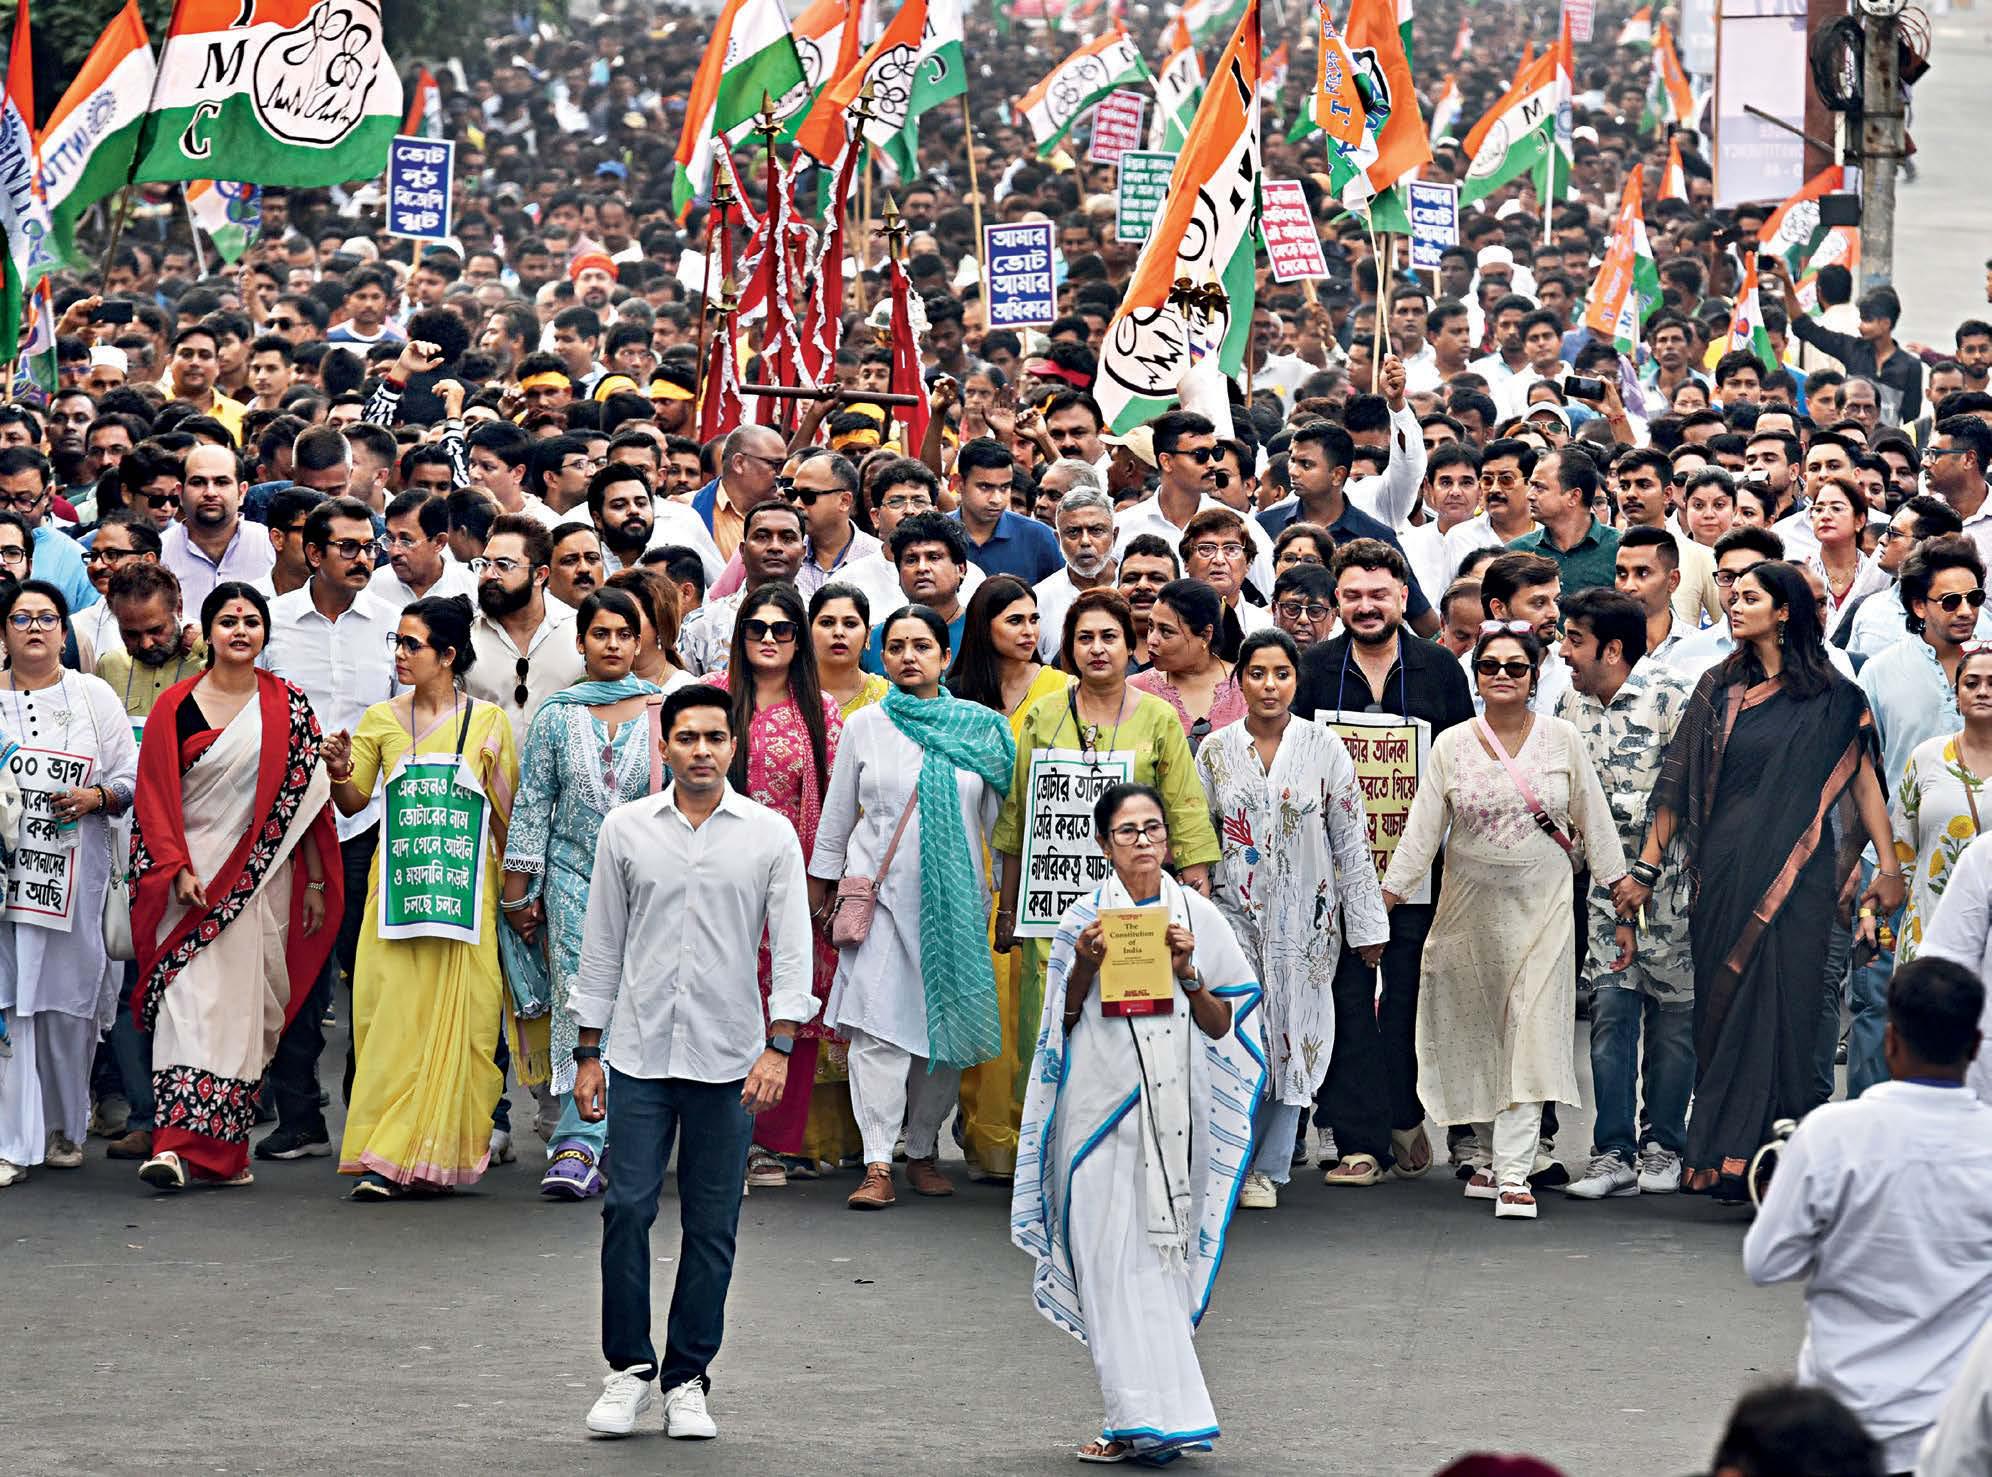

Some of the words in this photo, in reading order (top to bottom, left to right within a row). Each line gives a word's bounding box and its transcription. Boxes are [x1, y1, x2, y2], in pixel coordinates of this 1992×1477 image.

[397, 145, 447, 164] ভোট
[1413, 206, 1453, 225] ভোট
[991, 228, 1047, 248] আমার
[992, 249, 1048, 273] ভোট
[991, 272, 1050, 294] আমার
[992, 296, 1052, 321] অধিকার
[1373, 732, 1408, 763] তালিকা
[47, 757, 85, 786] ভাগ
[1036, 767, 1070, 802] ভোটার
[1075, 766, 1121, 803] তালিক
[1392, 768, 1415, 801] গিয়ে
[398, 777, 448, 798] একজনও
[399, 804, 447, 827] ভোটারের
[449, 809, 469, 830] নাম
[1055, 814, 1091, 841] করতে
[392, 838, 410, 858] বাদ
[413, 836, 442, 856] গেলে
[444, 835, 474, 861] আইনি
[19, 848, 66, 878] আপনাদের
[394, 868, 403, 886] ও
[406, 860, 444, 886] ময়দানি
[446, 867, 470, 890] লড়াই
[1031, 846, 1082, 886] নাগরিকত্ব
[25, 879, 63, 911] আছি
[404, 894, 432, 915] চলছে
[435, 895, 462, 917] চলবে
[1029, 891, 1052, 918] করা
